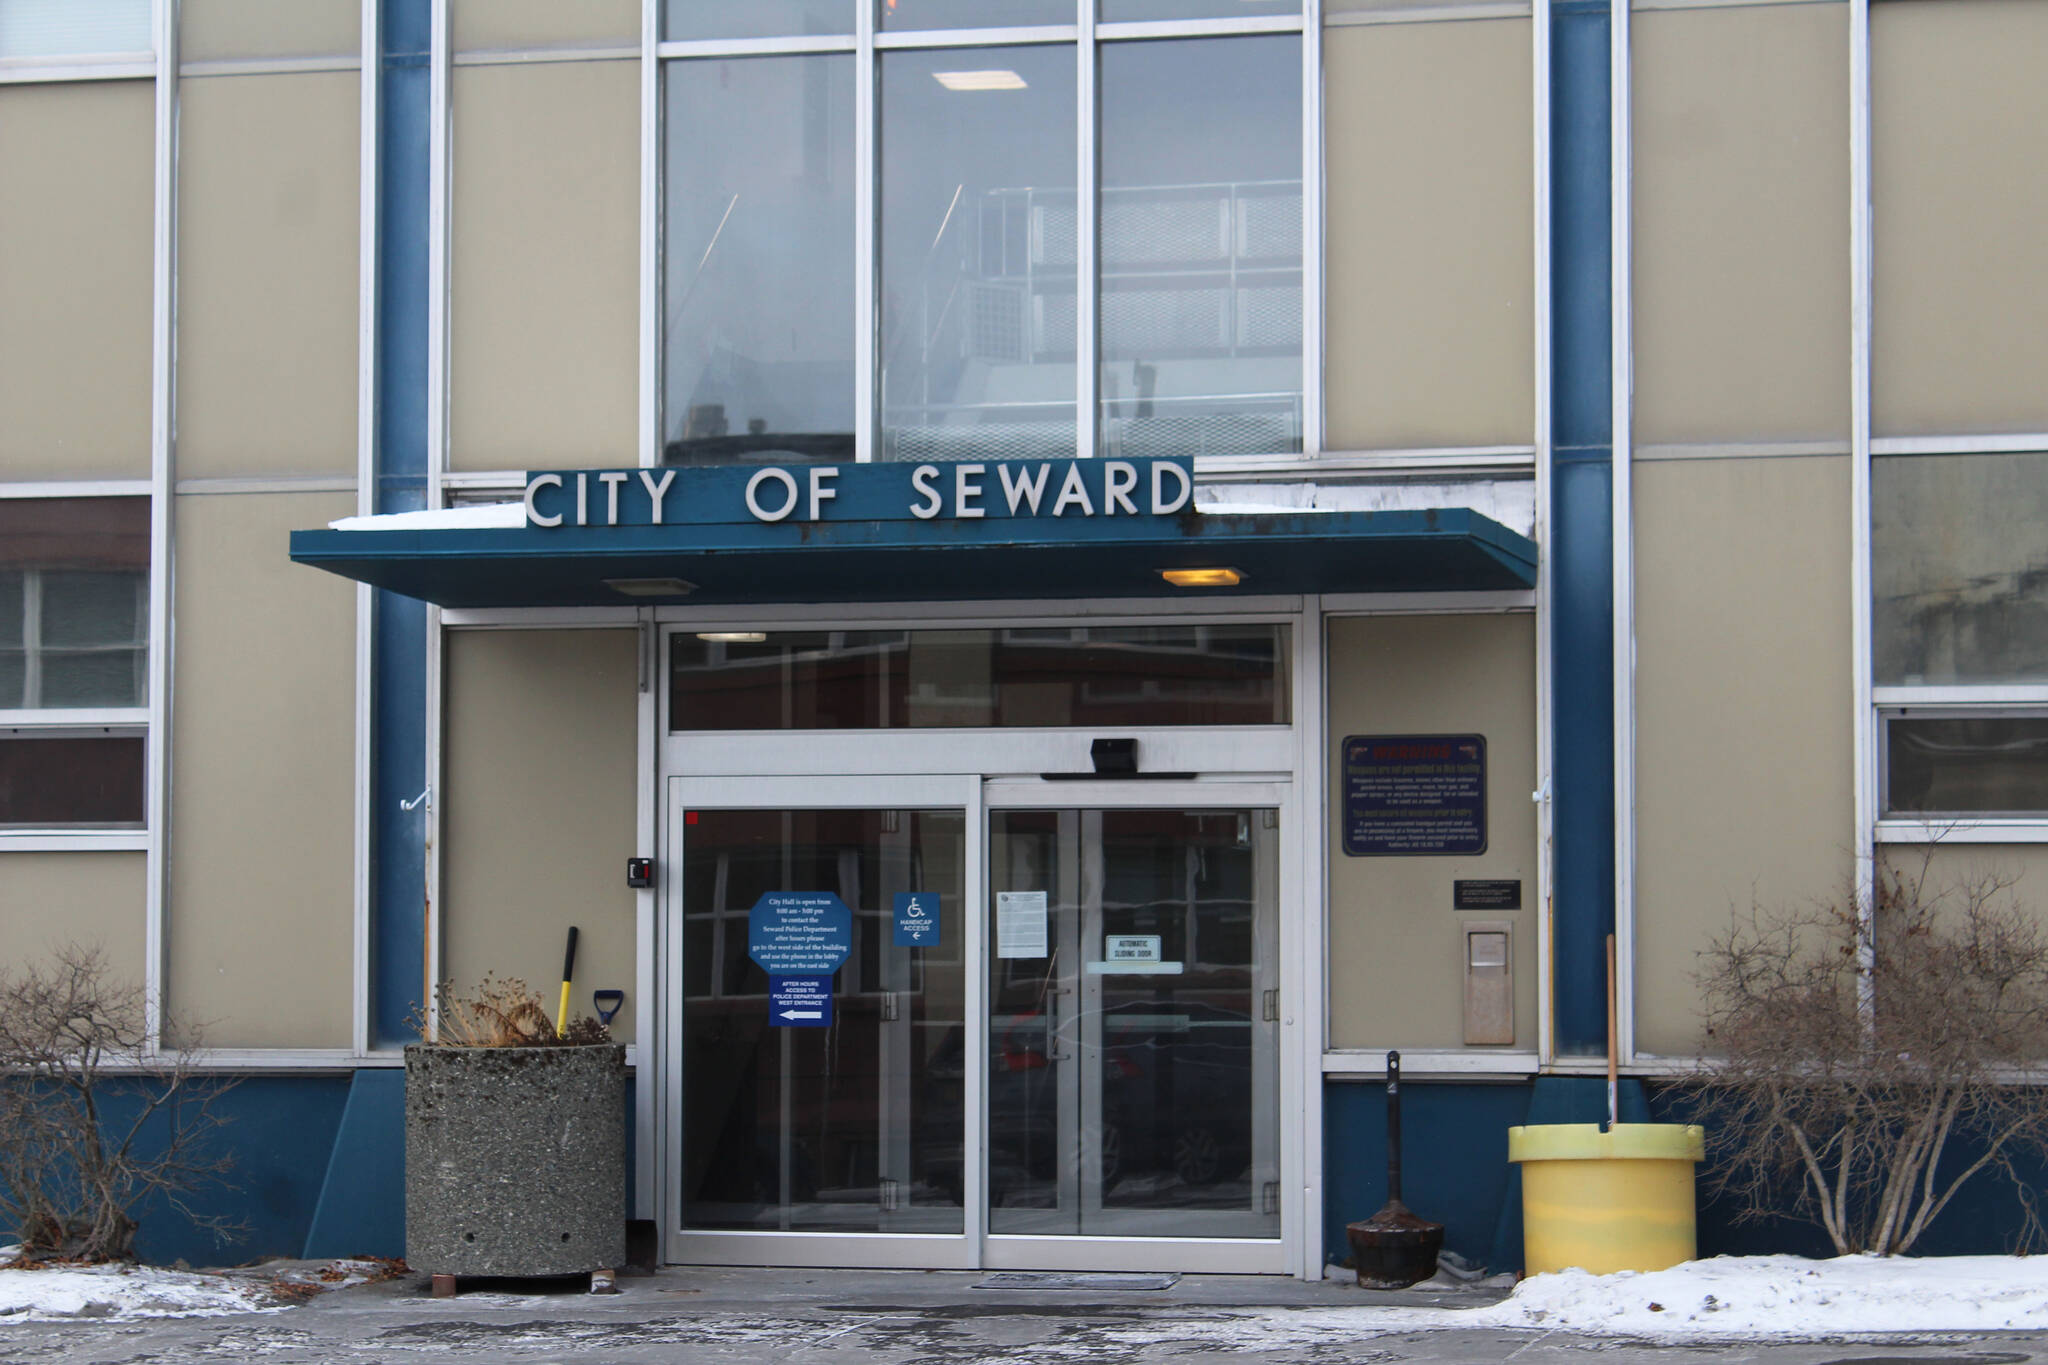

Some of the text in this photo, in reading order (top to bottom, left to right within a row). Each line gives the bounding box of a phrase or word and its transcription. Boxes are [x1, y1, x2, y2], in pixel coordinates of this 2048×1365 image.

[525, 461, 1191, 527] CITY OF SEWARD
[1374, 744, 1450, 759] WARNING
